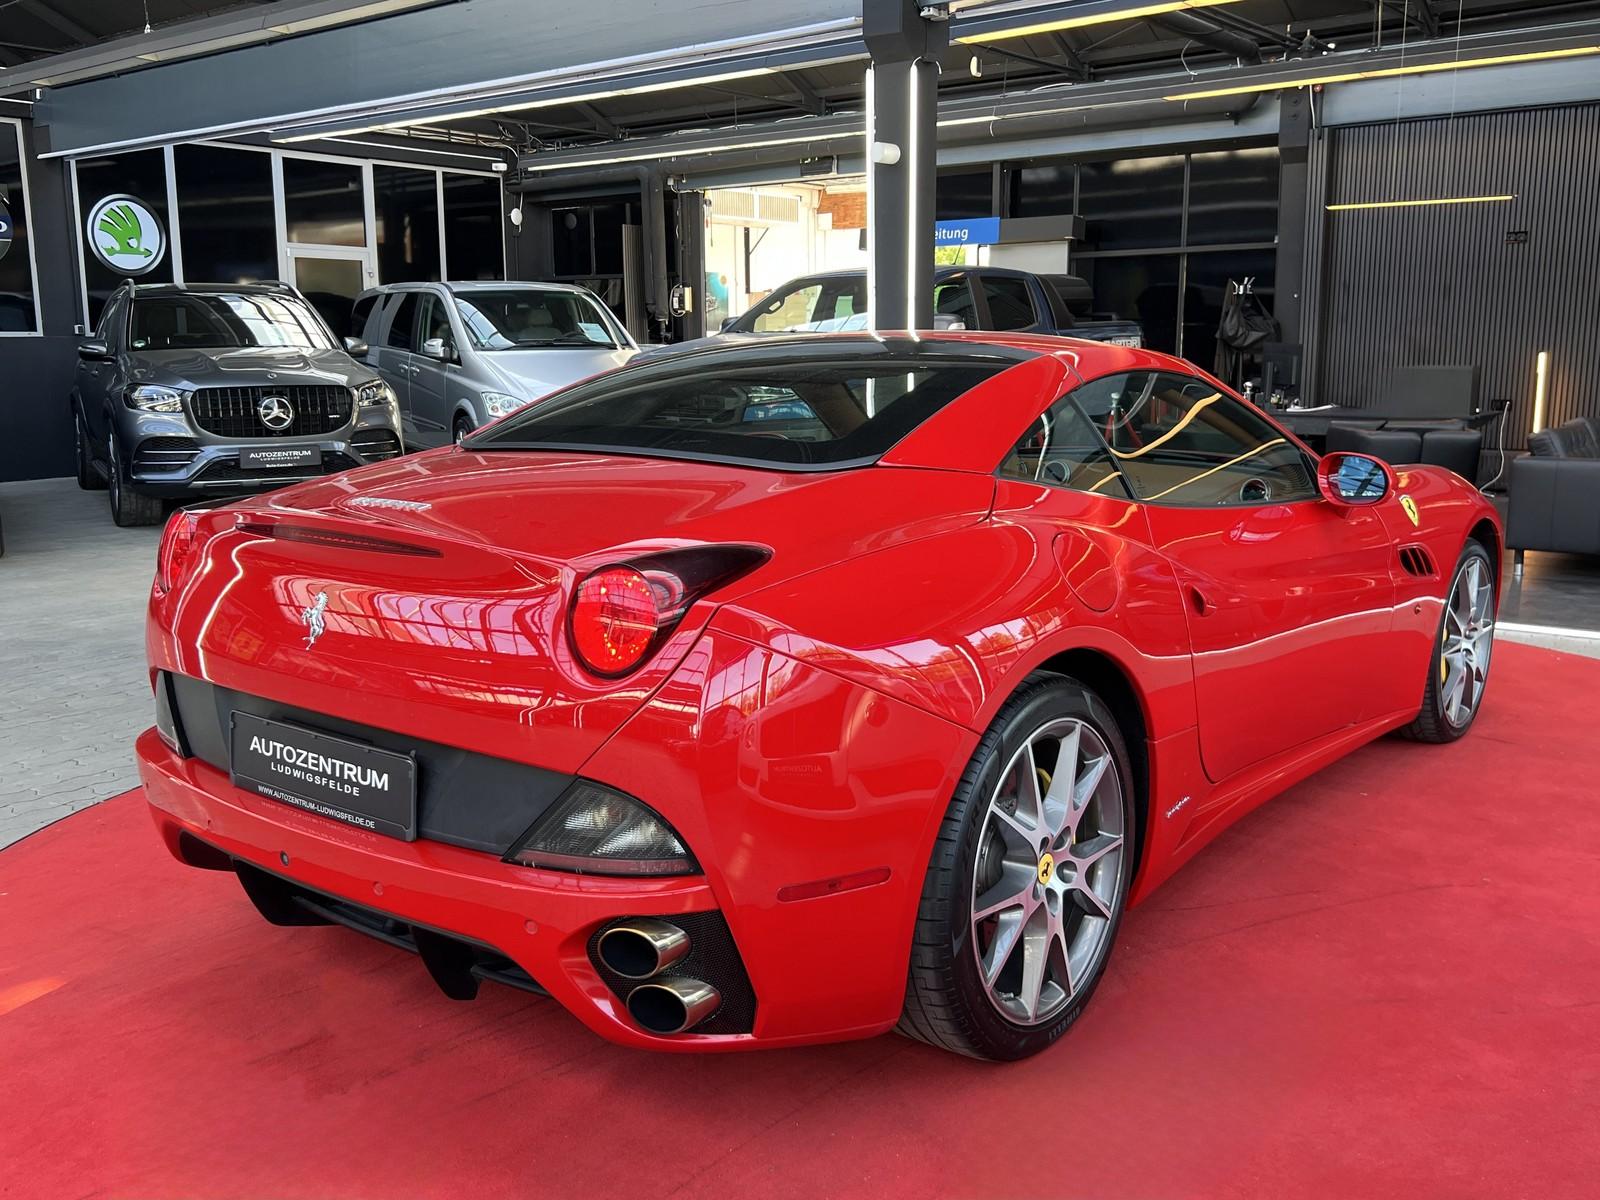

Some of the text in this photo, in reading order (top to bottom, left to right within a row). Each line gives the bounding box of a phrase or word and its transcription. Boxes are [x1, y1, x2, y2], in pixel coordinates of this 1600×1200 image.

[249, 450, 312, 459] AUTOZENTRUM
[250, 736, 389, 791] AUTOZENTRUM
[271, 762, 360, 797] LUDWIGSFELDE
[258, 785, 376, 829] WWW.AUTOZENTRUM-LUDWIGSFELDE.DE
